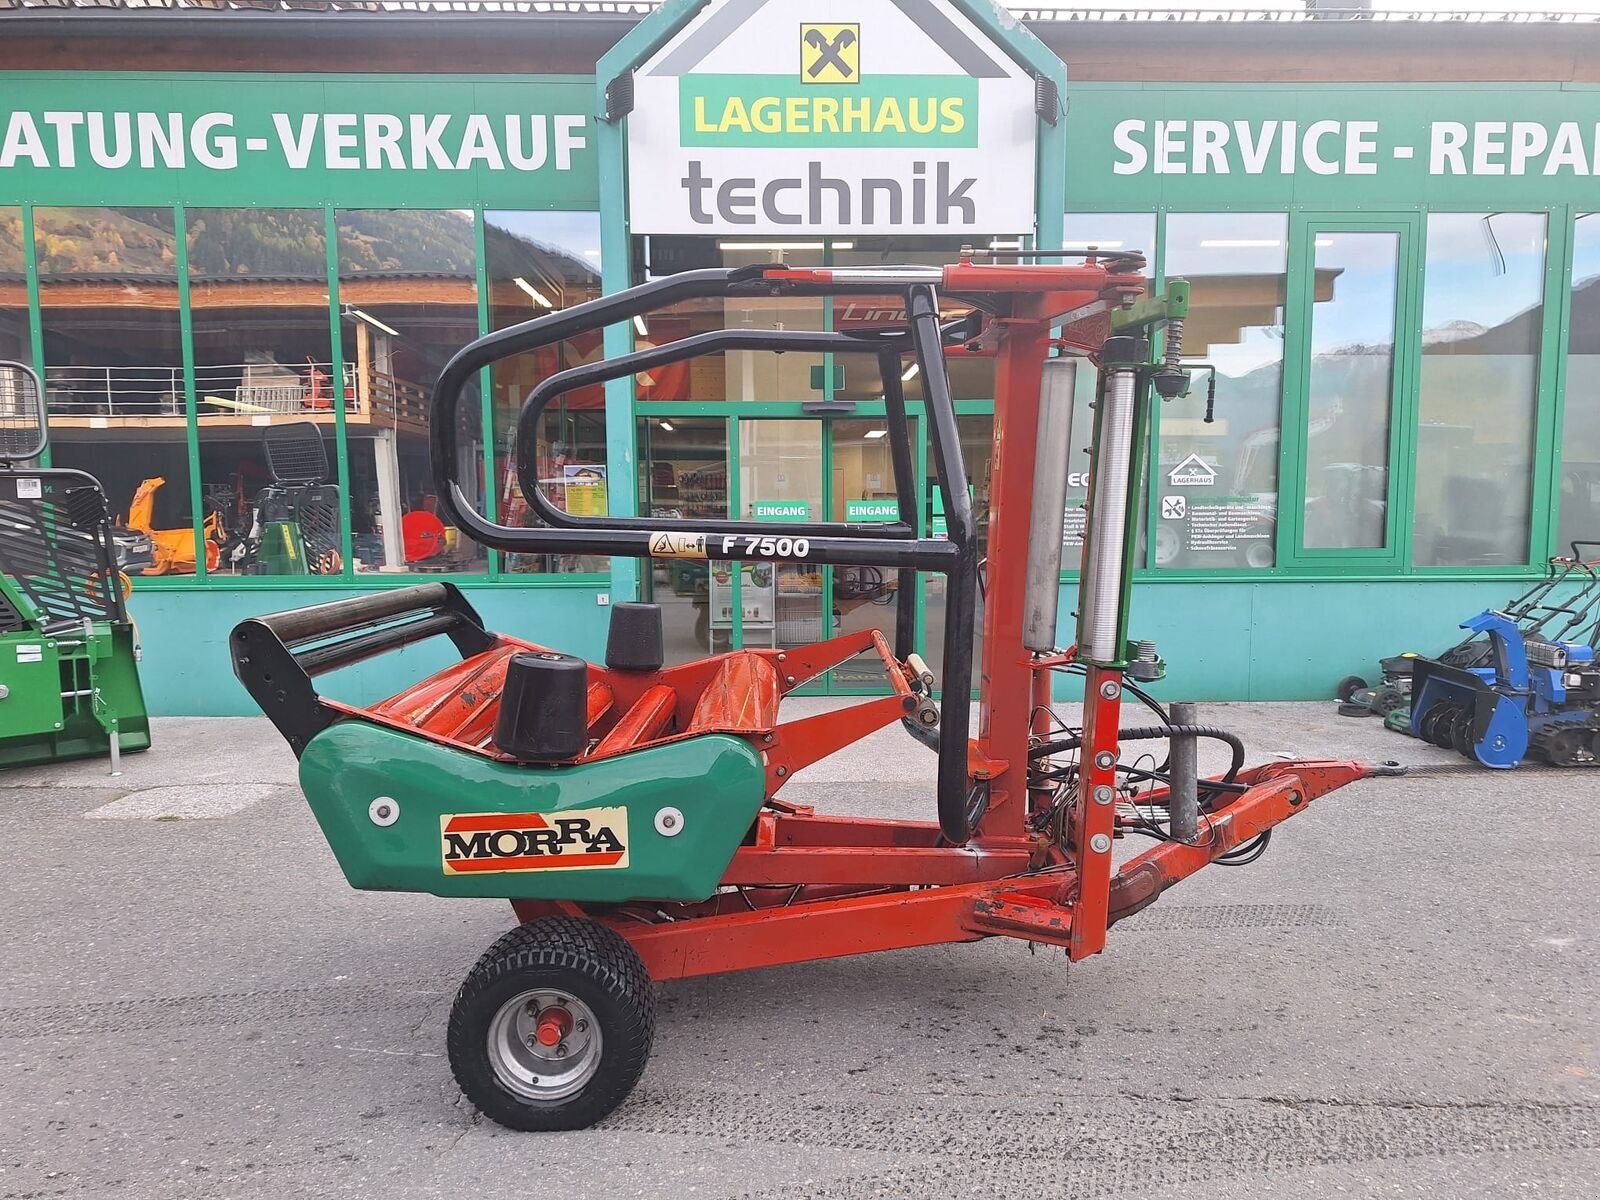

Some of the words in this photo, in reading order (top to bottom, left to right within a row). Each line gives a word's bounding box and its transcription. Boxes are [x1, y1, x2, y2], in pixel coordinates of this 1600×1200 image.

[694, 95, 965, 134] LAGERHAUS
[1112, 119, 1379, 176] SERVICE
[1429, 121, 1600, 176] REPA
[681, 160, 977, 225] technik
[757, 506, 806, 516] EINGANG
[849, 505, 897, 516] EINGANG
[722, 537, 737, 554] F
[745, 538, 810, 557] 7500
[444, 818, 626, 859] MORRA
